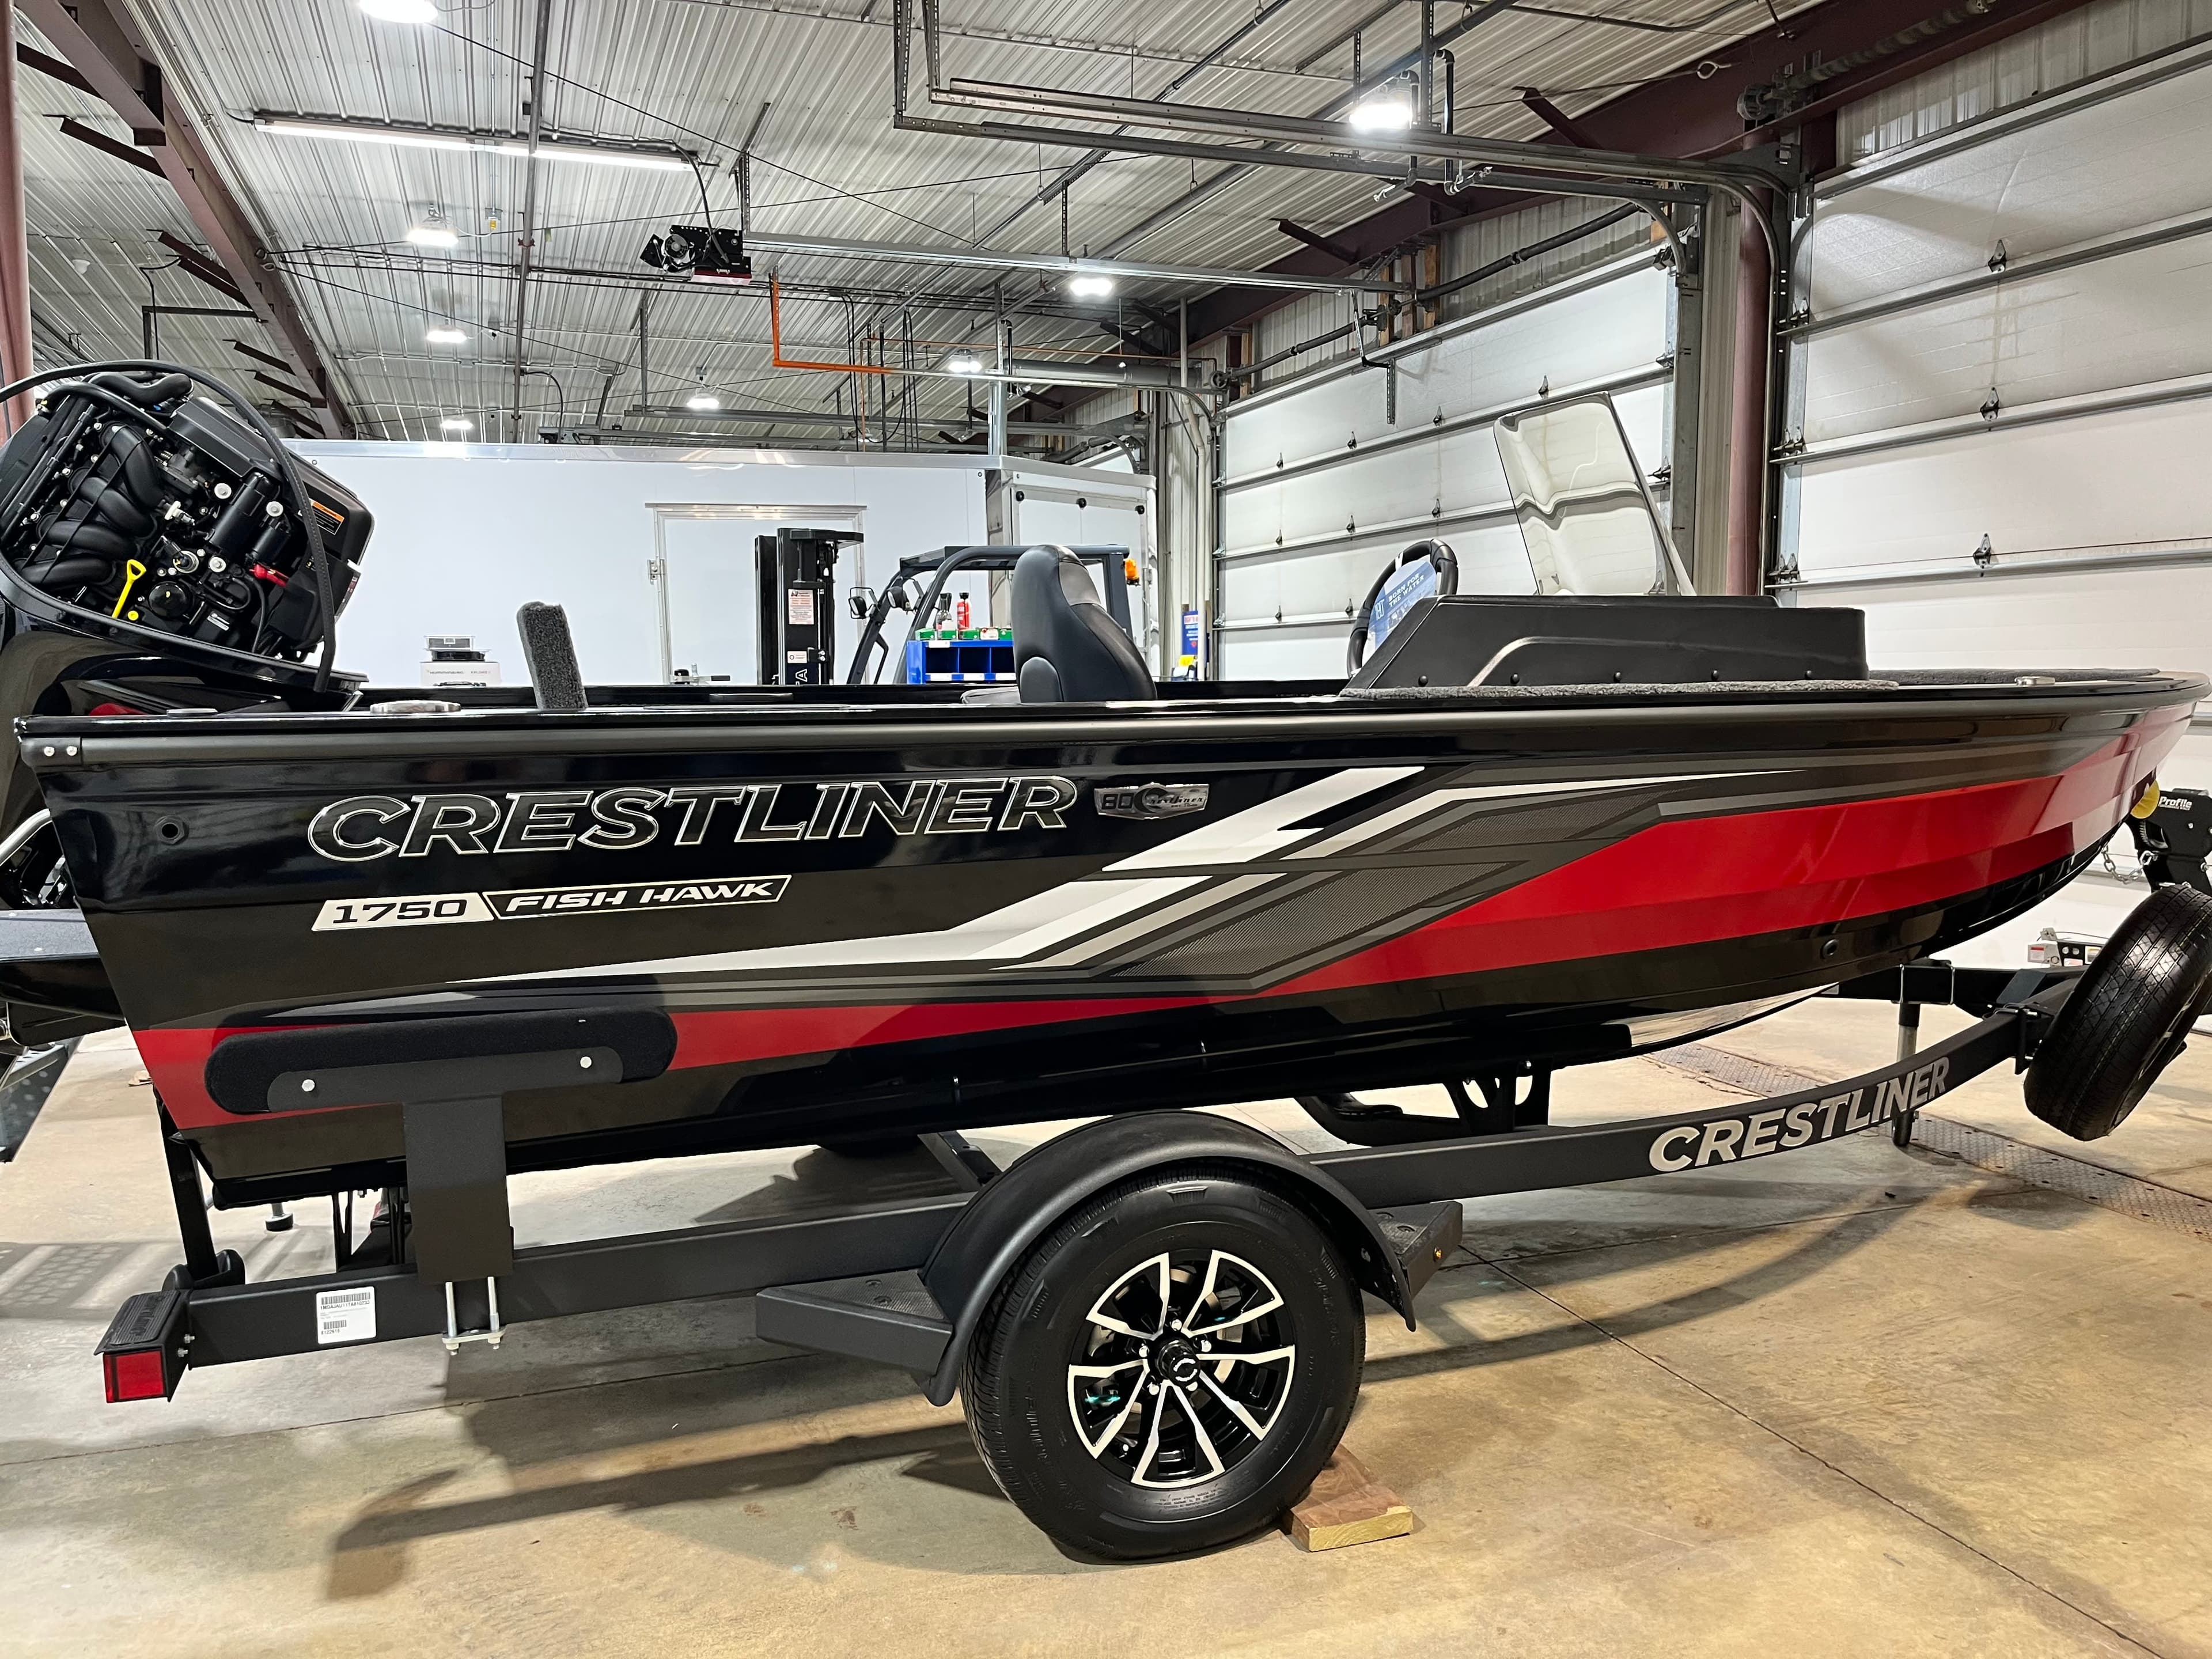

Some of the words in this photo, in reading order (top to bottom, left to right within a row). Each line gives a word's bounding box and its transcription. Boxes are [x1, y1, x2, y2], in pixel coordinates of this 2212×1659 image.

[1388, 584, 1406, 601] BORN
[1407, 573, 1419, 586] FOR
[1389, 595, 1402, 608] THE
[1403, 575, 1425, 596] WATER
[1101, 793, 1134, 810] 80
[2158, 796, 2192, 808] Profile
[307, 775, 1078, 862] CRESTLINER
[332, 900, 468, 924] 1750
[505, 890, 628, 912] FISH
[639, 882, 775, 905] HAWK
[1649, 1056, 1949, 1172] CRESTLINER
